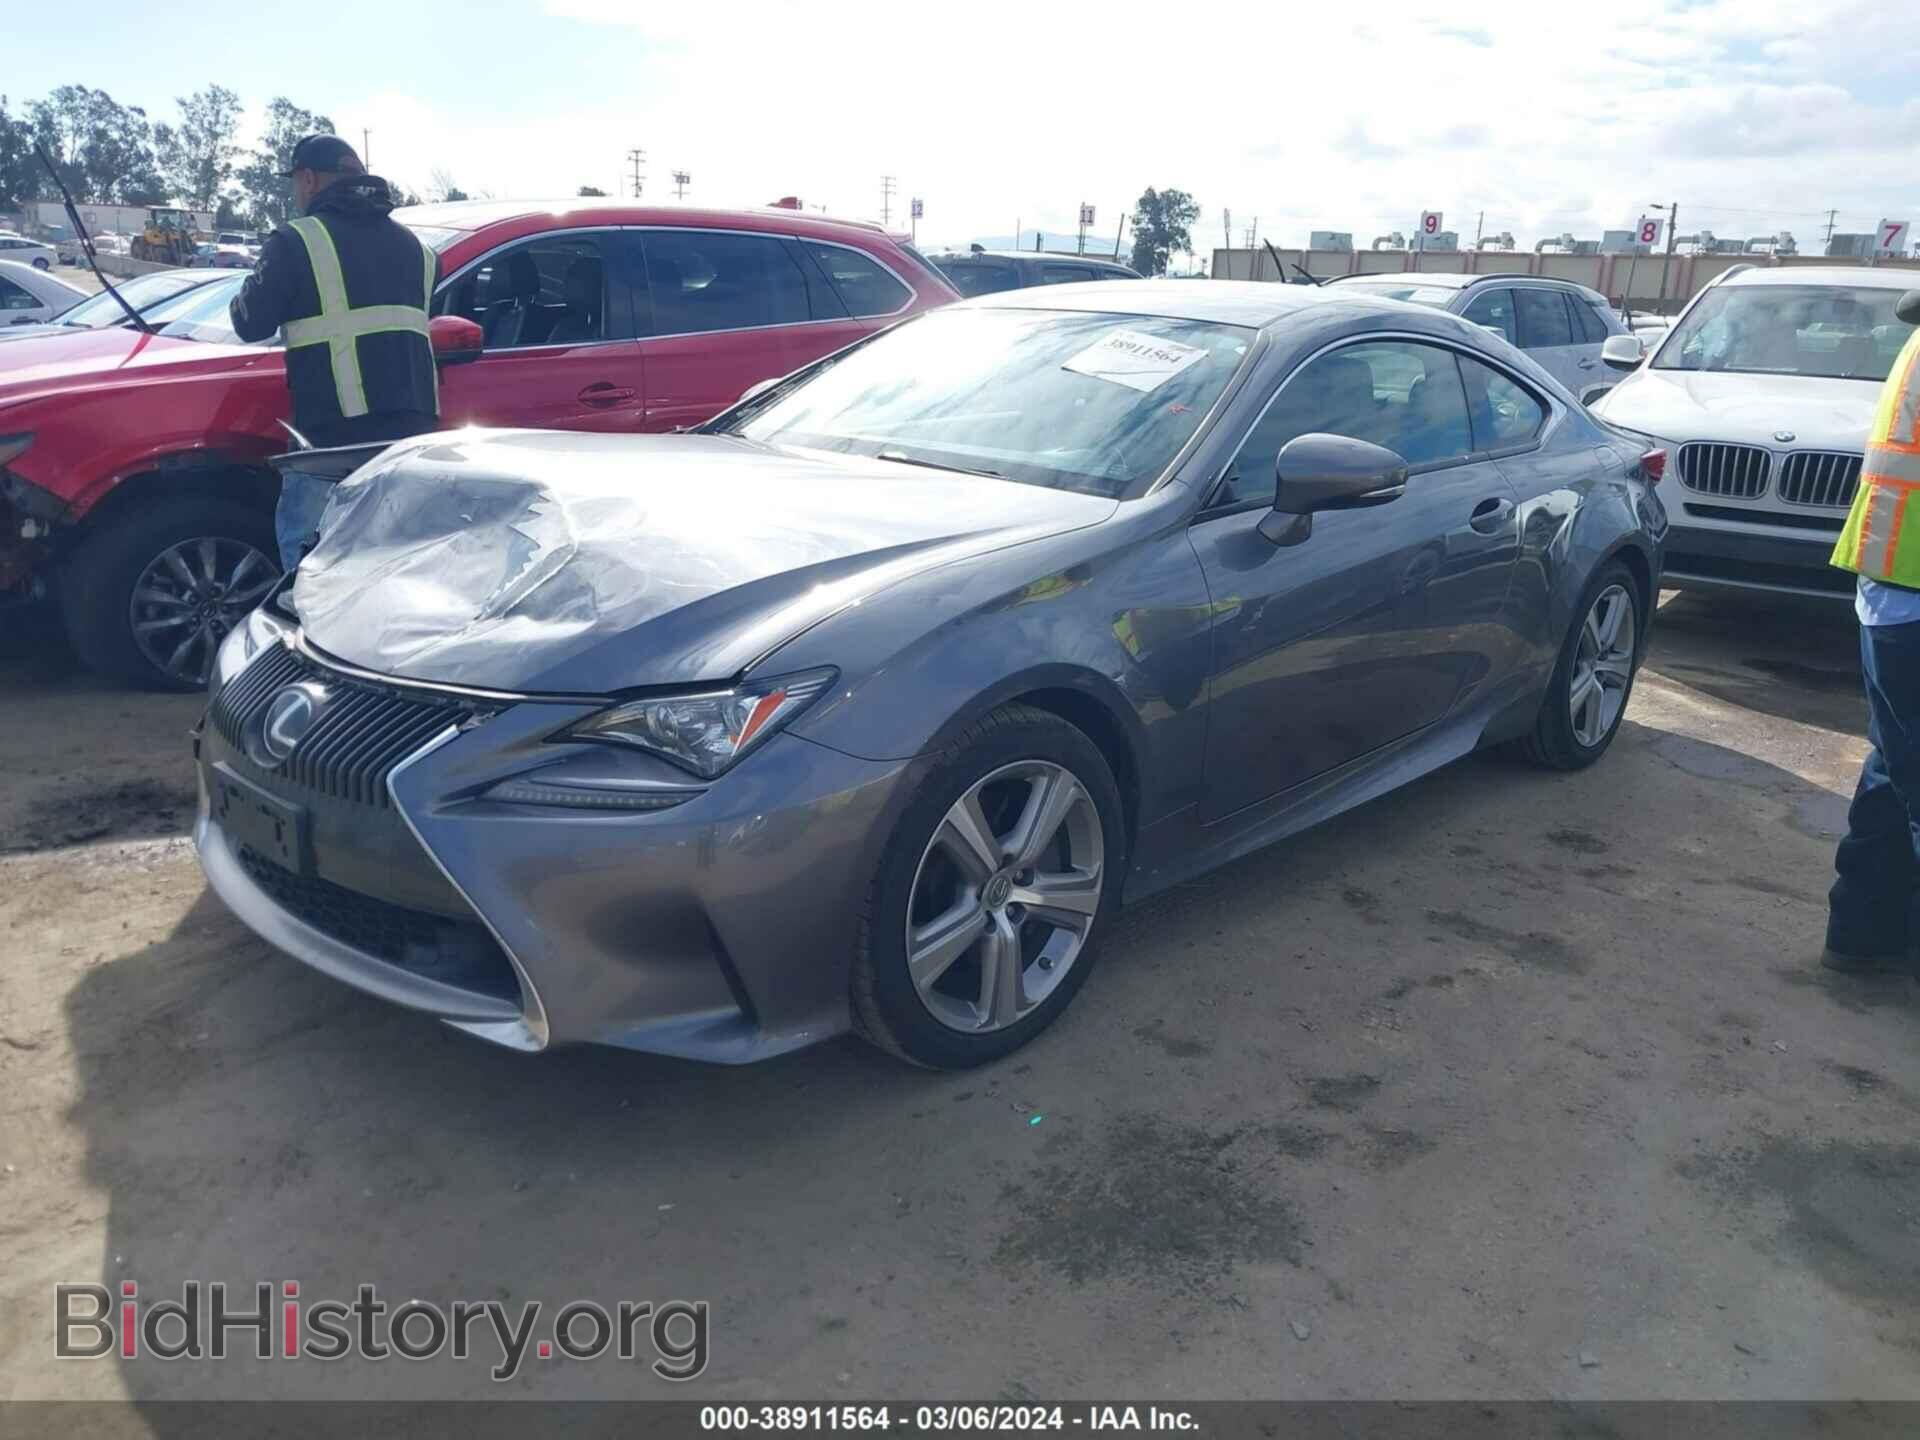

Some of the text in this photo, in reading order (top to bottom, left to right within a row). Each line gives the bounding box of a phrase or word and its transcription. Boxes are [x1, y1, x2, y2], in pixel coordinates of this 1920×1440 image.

[1425, 215, 1437, 234] 9
[1641, 222, 1656, 242] 8
[1883, 224, 1902, 247] 7
